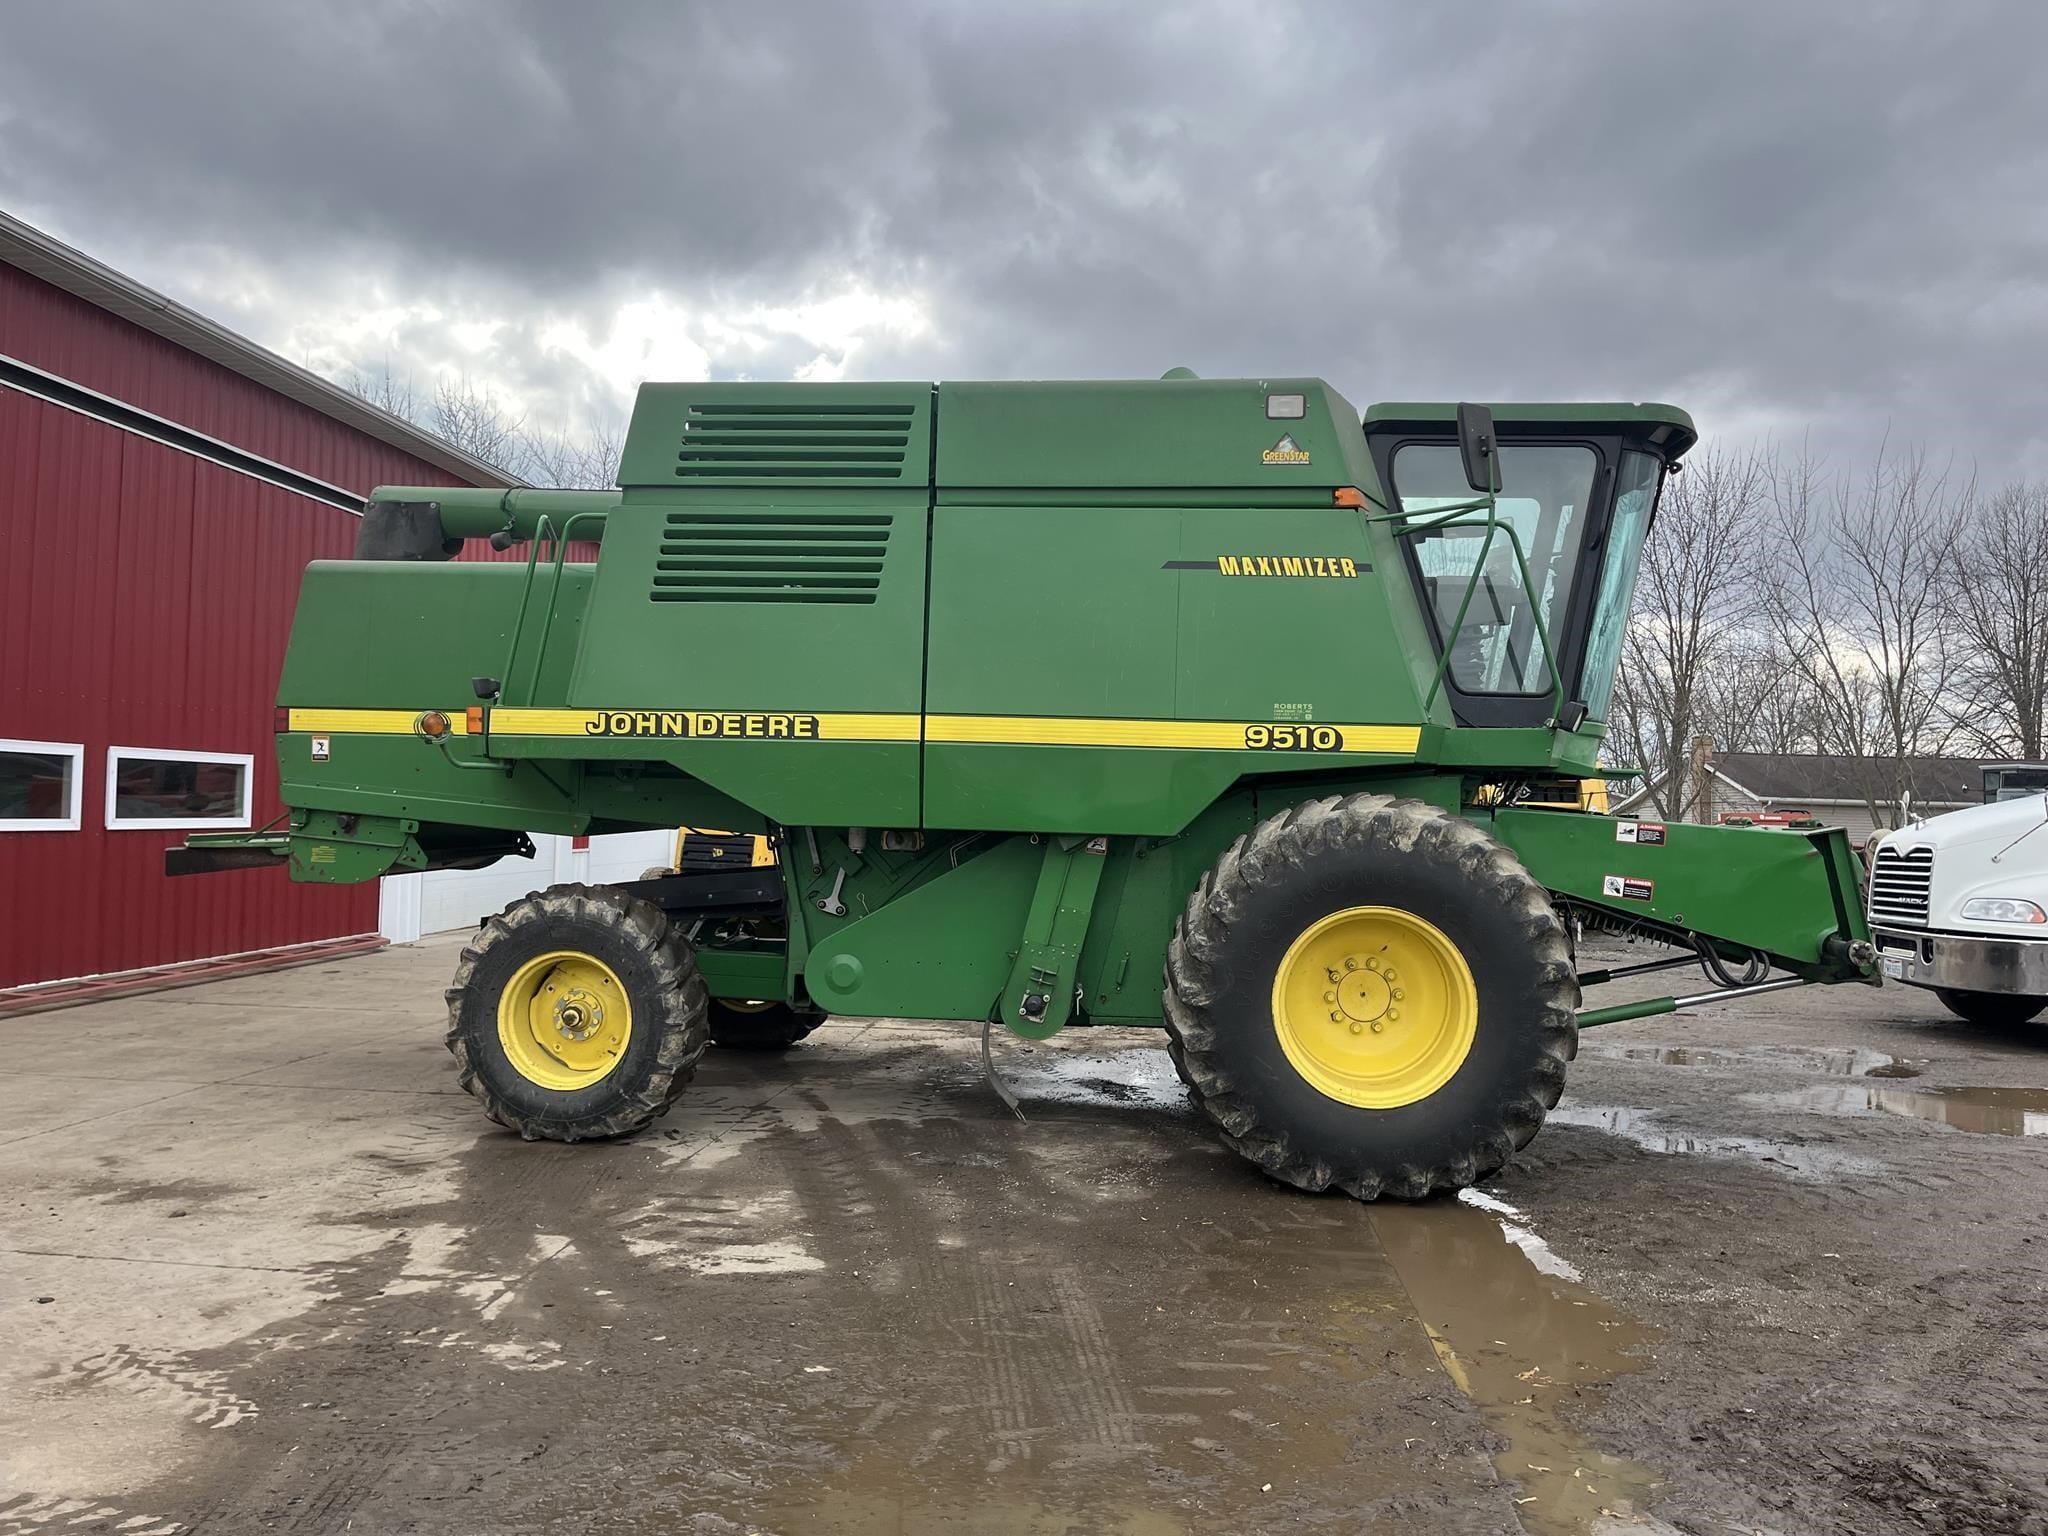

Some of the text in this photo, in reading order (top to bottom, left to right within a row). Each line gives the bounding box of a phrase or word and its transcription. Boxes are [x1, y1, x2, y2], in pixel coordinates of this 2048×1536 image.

[1217, 556, 1358, 578] MAXIMIZER
[586, 712, 818, 738] JOHN DEERE
[1245, 725, 1341, 750] 9510
